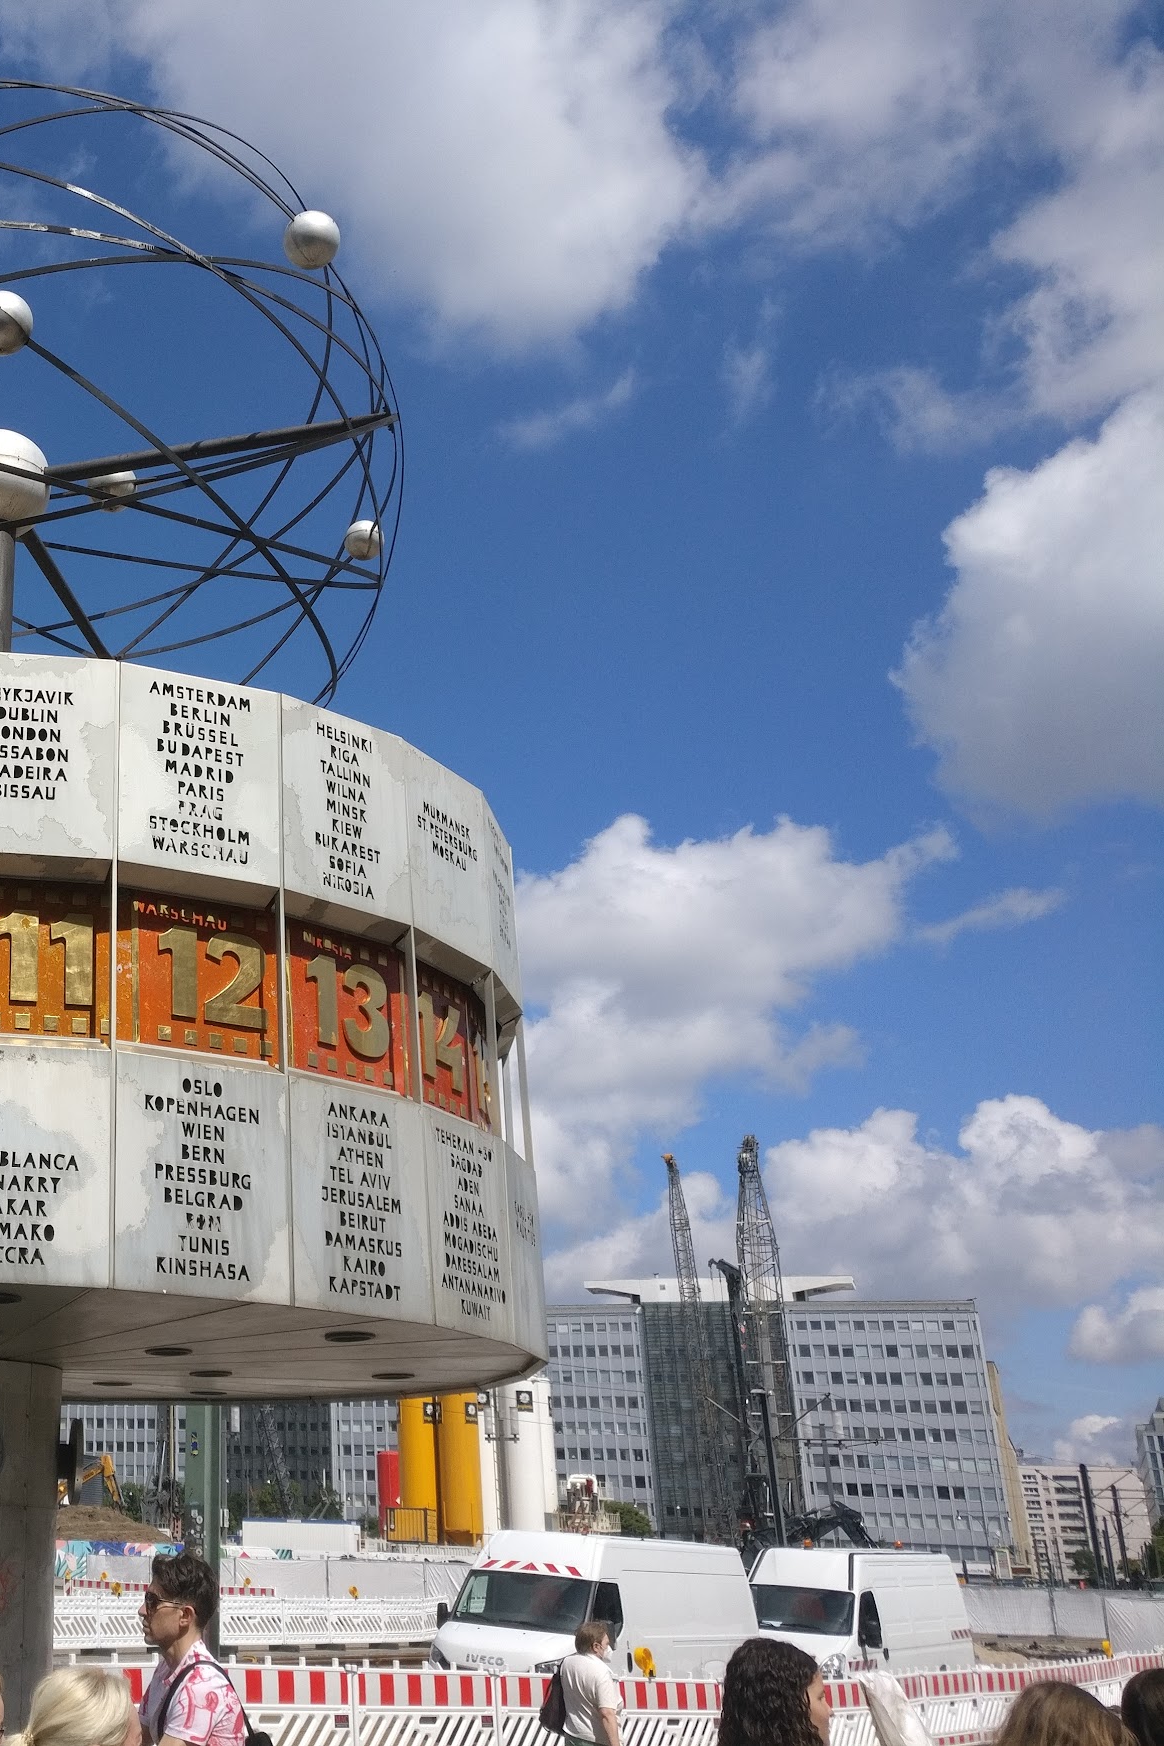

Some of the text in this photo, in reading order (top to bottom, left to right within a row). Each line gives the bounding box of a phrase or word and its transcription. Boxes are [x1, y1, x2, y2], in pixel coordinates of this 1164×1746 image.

[149, 681, 251, 712] AMSTERDAM
[170, 702, 230, 727] BERLIN
[162, 719, 238, 747] BRÜSSEL
[316, 721, 372, 754] HELSINKI
[156, 737, 244, 767] BUDAPEST
[330, 744, 360, 767] RIGA
[165, 759, 234, 784] MADRID
[320, 759, 371, 788] TALLINN
[177, 780, 224, 802] PARIS
[325, 779, 367, 805] WILNA
[178, 800, 224, 821] PRAG
[326, 798, 367, 823] MINSK
[423, 800, 471, 841] MURMANSK
[149, 815, 250, 846] STOCKHOLM
[332, 817, 362, 840] KIEW
[417, 814, 428, 832] ST.
[430, 823, 478, 862] PETERSBURG
[151, 834, 248, 865] WARSCHAU
[315, 831, 381, 864] BUKAREST
[432, 840, 467, 872] MOSKAU
[329, 855, 367, 879] SOFIA
[323, 872, 375, 900] NIKOSIA
[157, 926, 268, 1031] 12
[305, 953, 391, 1060] 13
[418, 991, 465, 1094] 14
[182, 1078, 222, 1098] OSLO
[144, 1094, 260, 1124] KOPENHAGEN
[328, 1101, 390, 1128] ANKARA
[181, 1121, 224, 1142] WIEN
[326, 1122, 392, 1150] ISTANBUL
[436, 1127, 475, 1156] TEHERAN
[181, 1143, 225, 1164] BERN
[337, 1146, 383, 1169] ATHEN
[154, 1162, 251, 1190] PRESSBURG
[329, 1165, 391, 1191] TEL AVIV
[457, 1176, 480, 1197] ADEN
[164, 1187, 243, 1212] BELGRAD
[322, 1185, 402, 1214] JERUSALEM
[454, 1194, 485, 1218] SANAA
[185, 1212, 222, 1232] ROM
[339, 1210, 386, 1233] BEIRUT
[443, 1211, 498, 1243] ADDIS ABEBA
[178, 1235, 230, 1256] TUNIS
[325, 1230, 402, 1257] DAMASKUS
[444, 1231, 499, 1263] MOGADISCHU
[156, 1256, 250, 1282] KINSHASA
[343, 1255, 386, 1277] KAIRO
[445, 1252, 500, 1283] DARESSALAM
[329, 1276, 401, 1301] KAPSTADT
[441, 1273, 506, 1305] ANTANANARIVO
[461, 1298, 491, 1321] KUWAIT
[466, 1653, 505, 1666] IVECO
